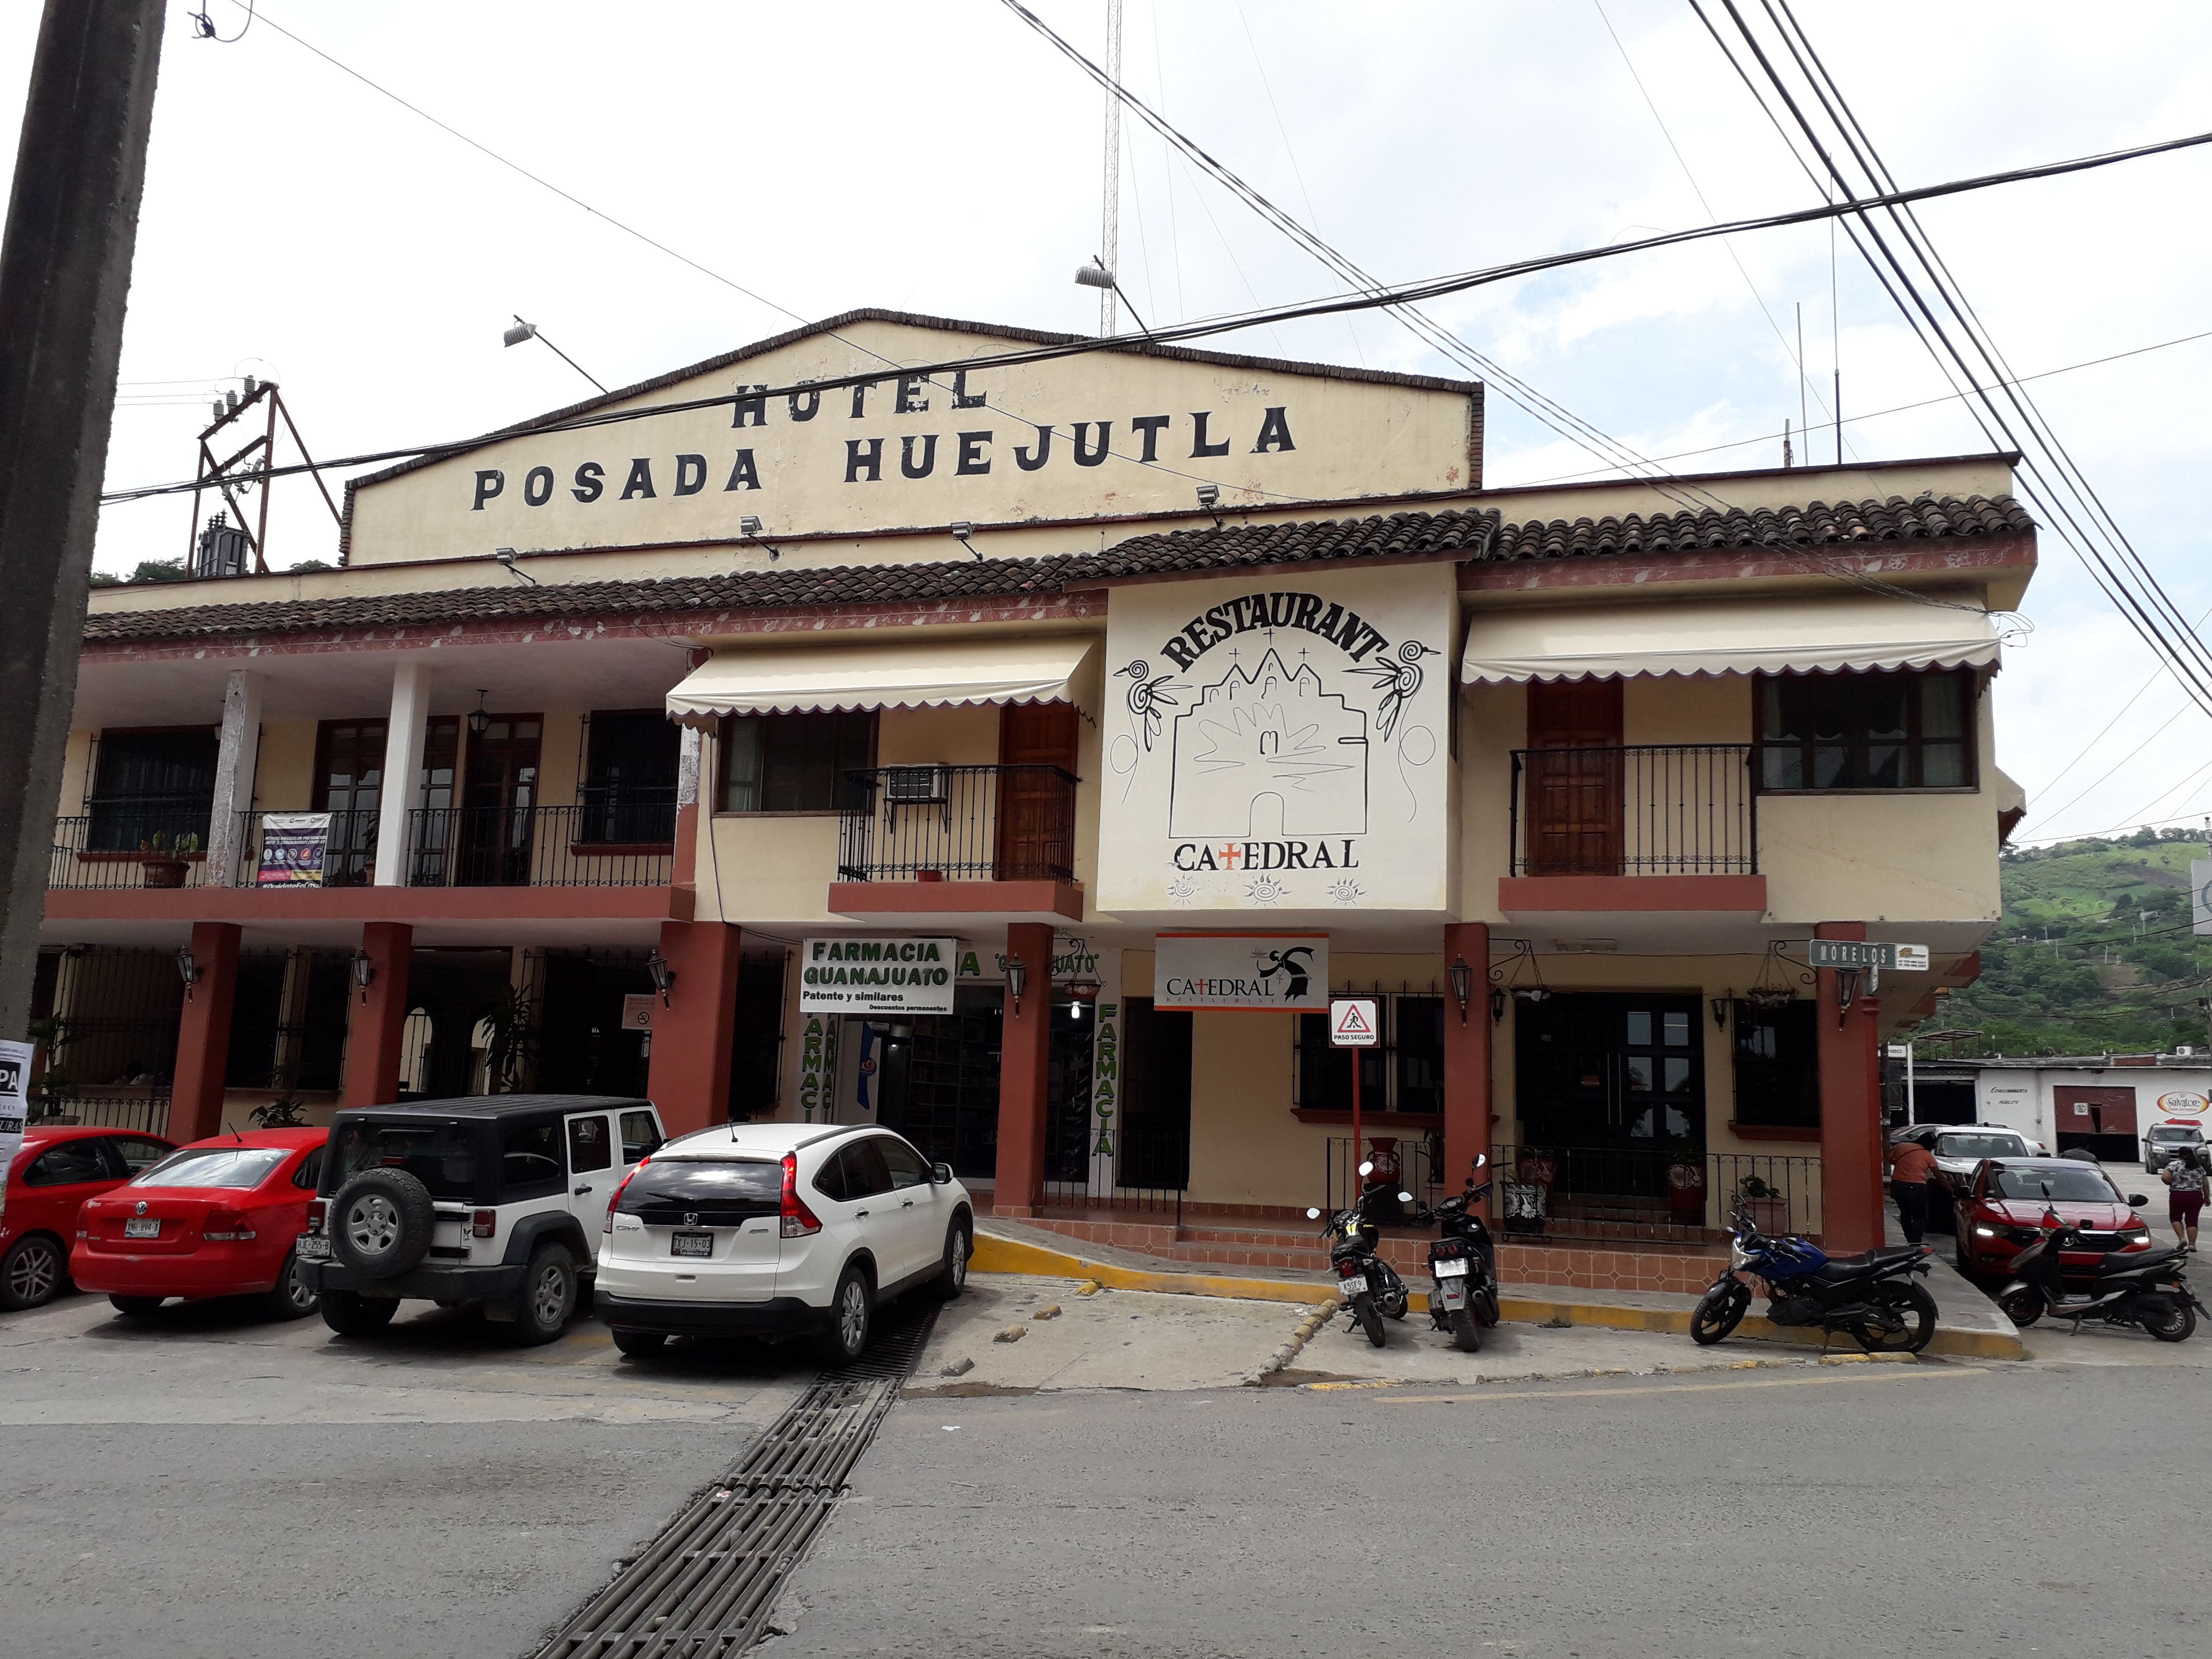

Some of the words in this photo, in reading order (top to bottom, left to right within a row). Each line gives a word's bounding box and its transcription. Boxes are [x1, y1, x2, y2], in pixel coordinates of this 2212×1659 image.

[730, 370, 987, 428] HOTEL
[469, 449, 762, 511] POSADA
[843, 406, 1297, 483] HUEJUTLA
[1160, 592, 1390, 674] RESTAURANT
[1174, 839, 1359, 871] CATEDRAL
[812, 942, 940, 962] FARMACIA
[1820, 945, 1886, 964] MORELOS
[804, 967, 948, 986] GUANAJUATO
[803, 991, 844, 1000] Patente
[846, 993, 853, 1002] y
[855, 991, 903, 1002] similares
[1167, 978, 1275, 996] CATEDRAL
[1092, 1004, 1117, 1157] FARMACIA
[2168, 1097, 2201, 1107] Salvatore
